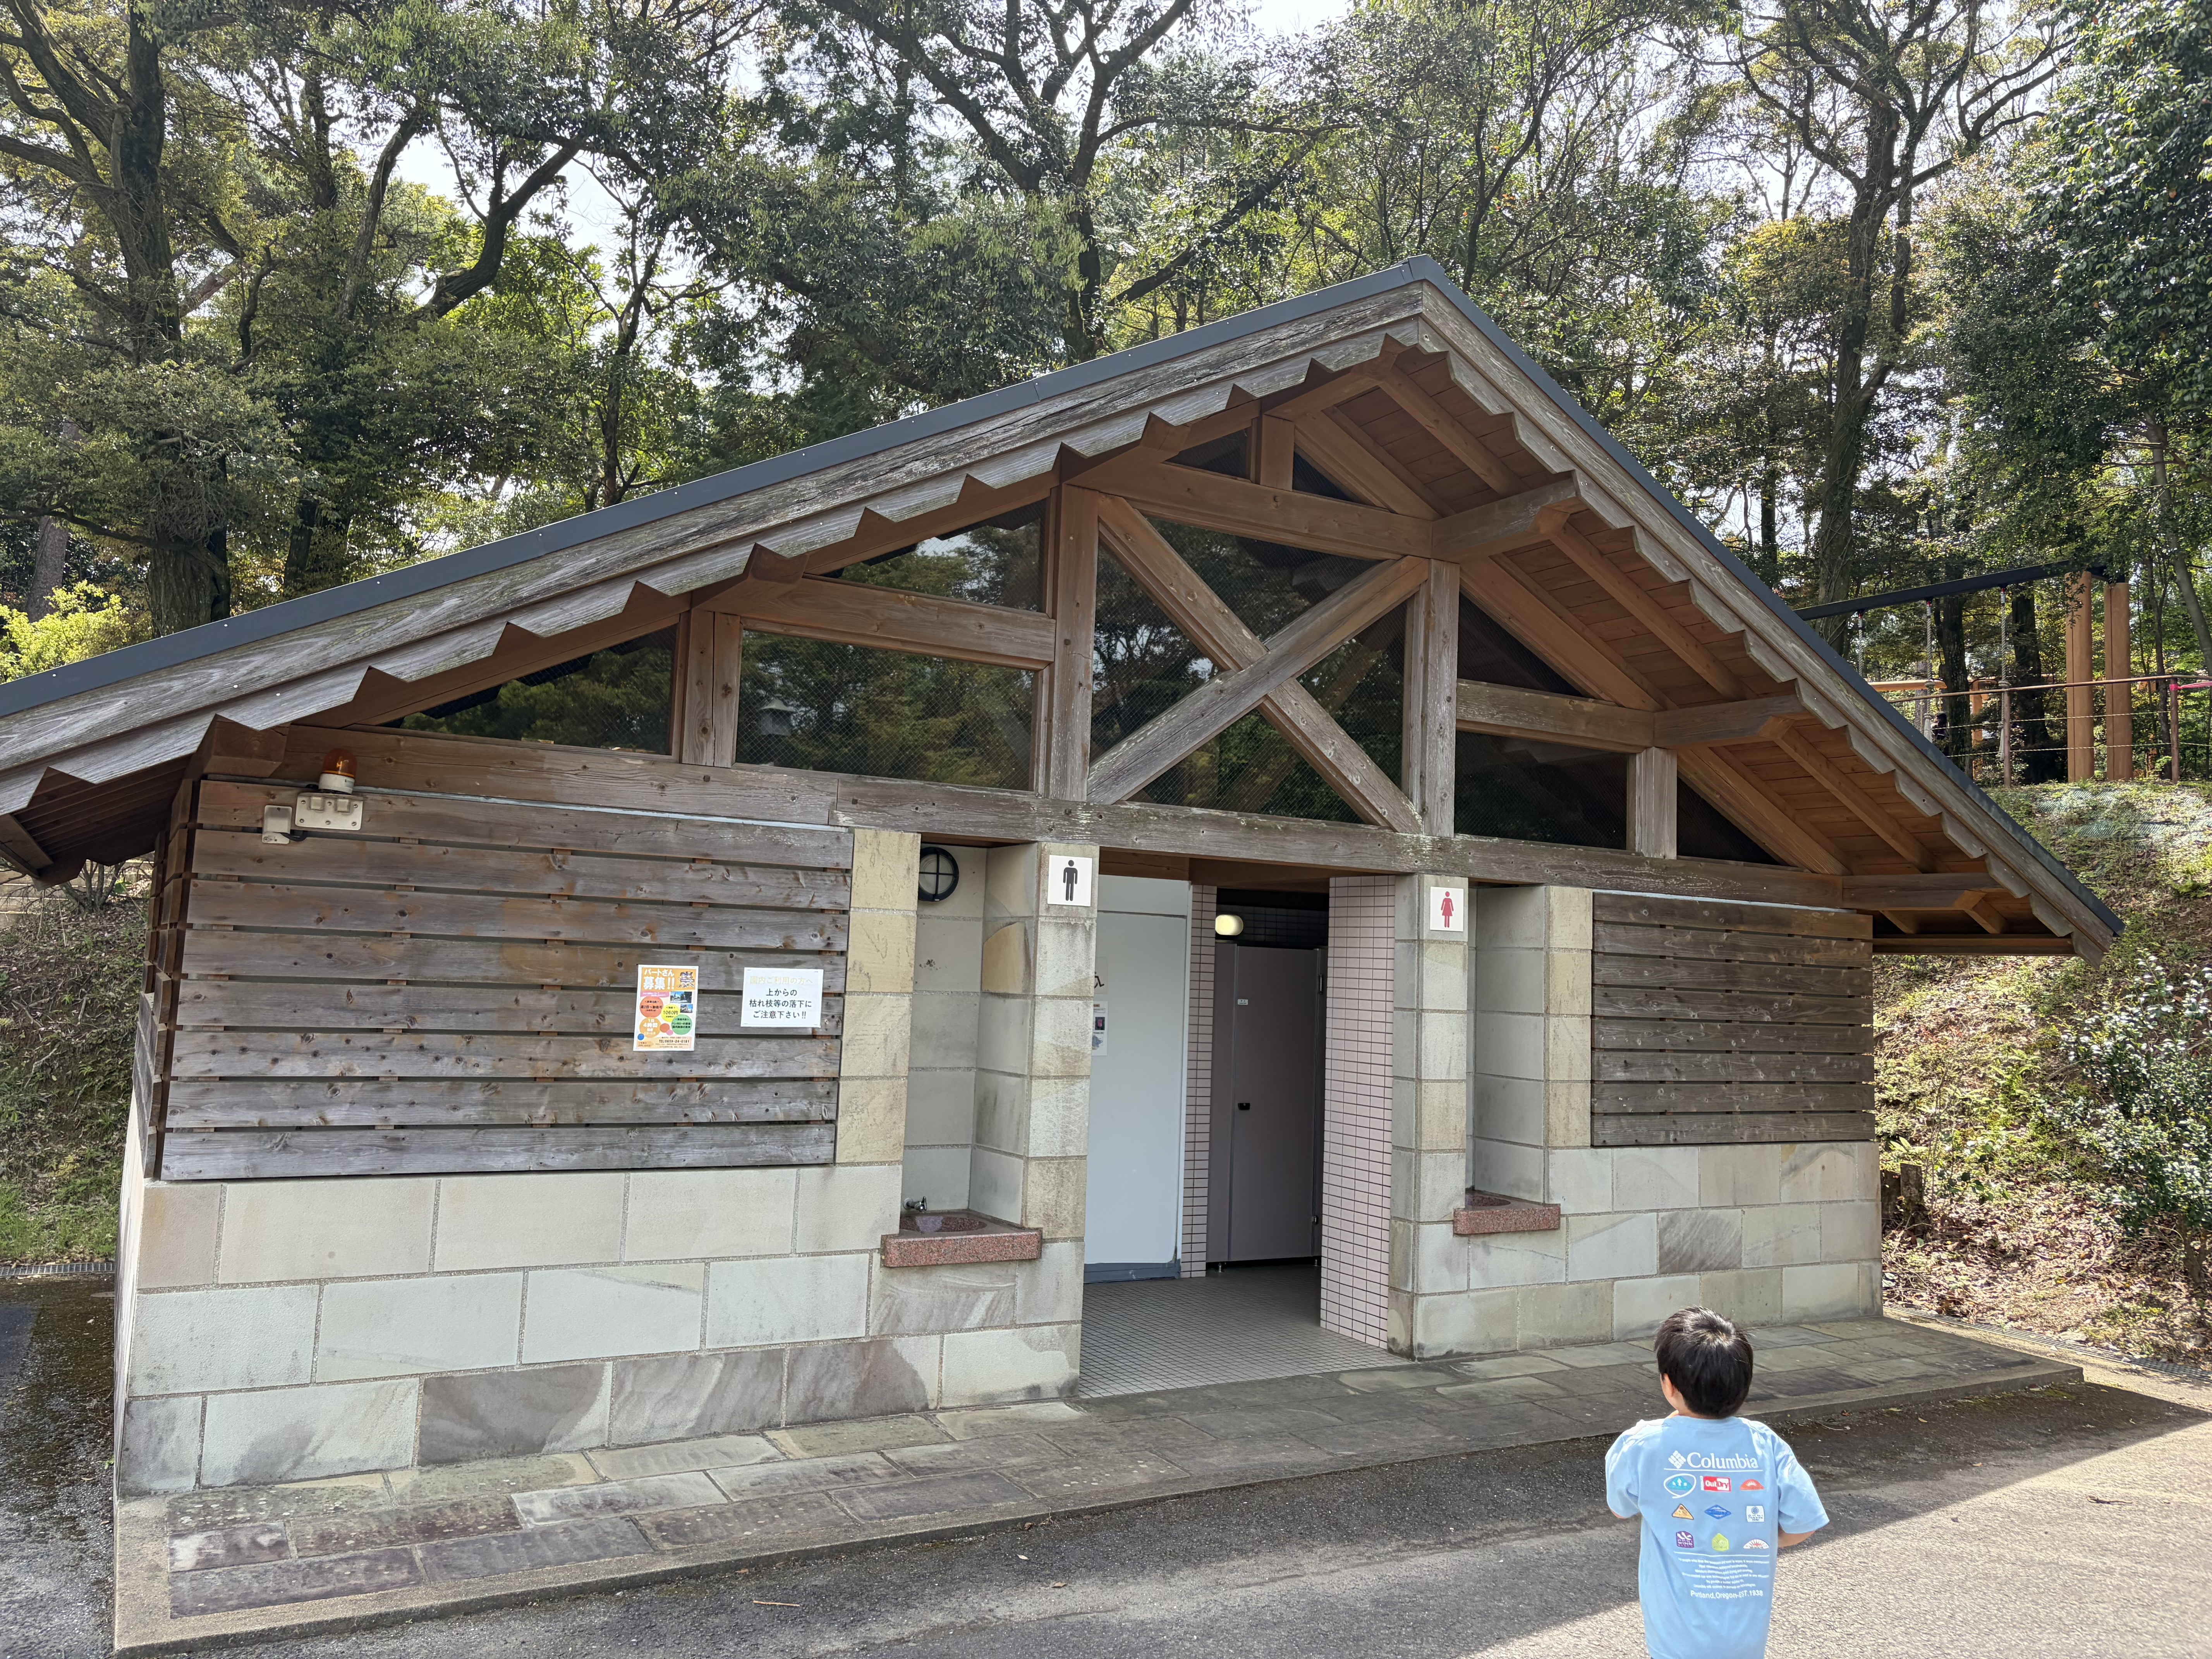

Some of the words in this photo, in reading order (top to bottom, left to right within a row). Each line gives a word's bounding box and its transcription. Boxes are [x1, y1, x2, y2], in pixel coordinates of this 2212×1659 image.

[750, 976, 813, 985] 園内ご利用の方へ
[766, 988, 797, 996] 上からの
[749, 999, 812, 1008] 枯れ枝等の落下に
[1687, 1452, 1759, 1469] Columbia
